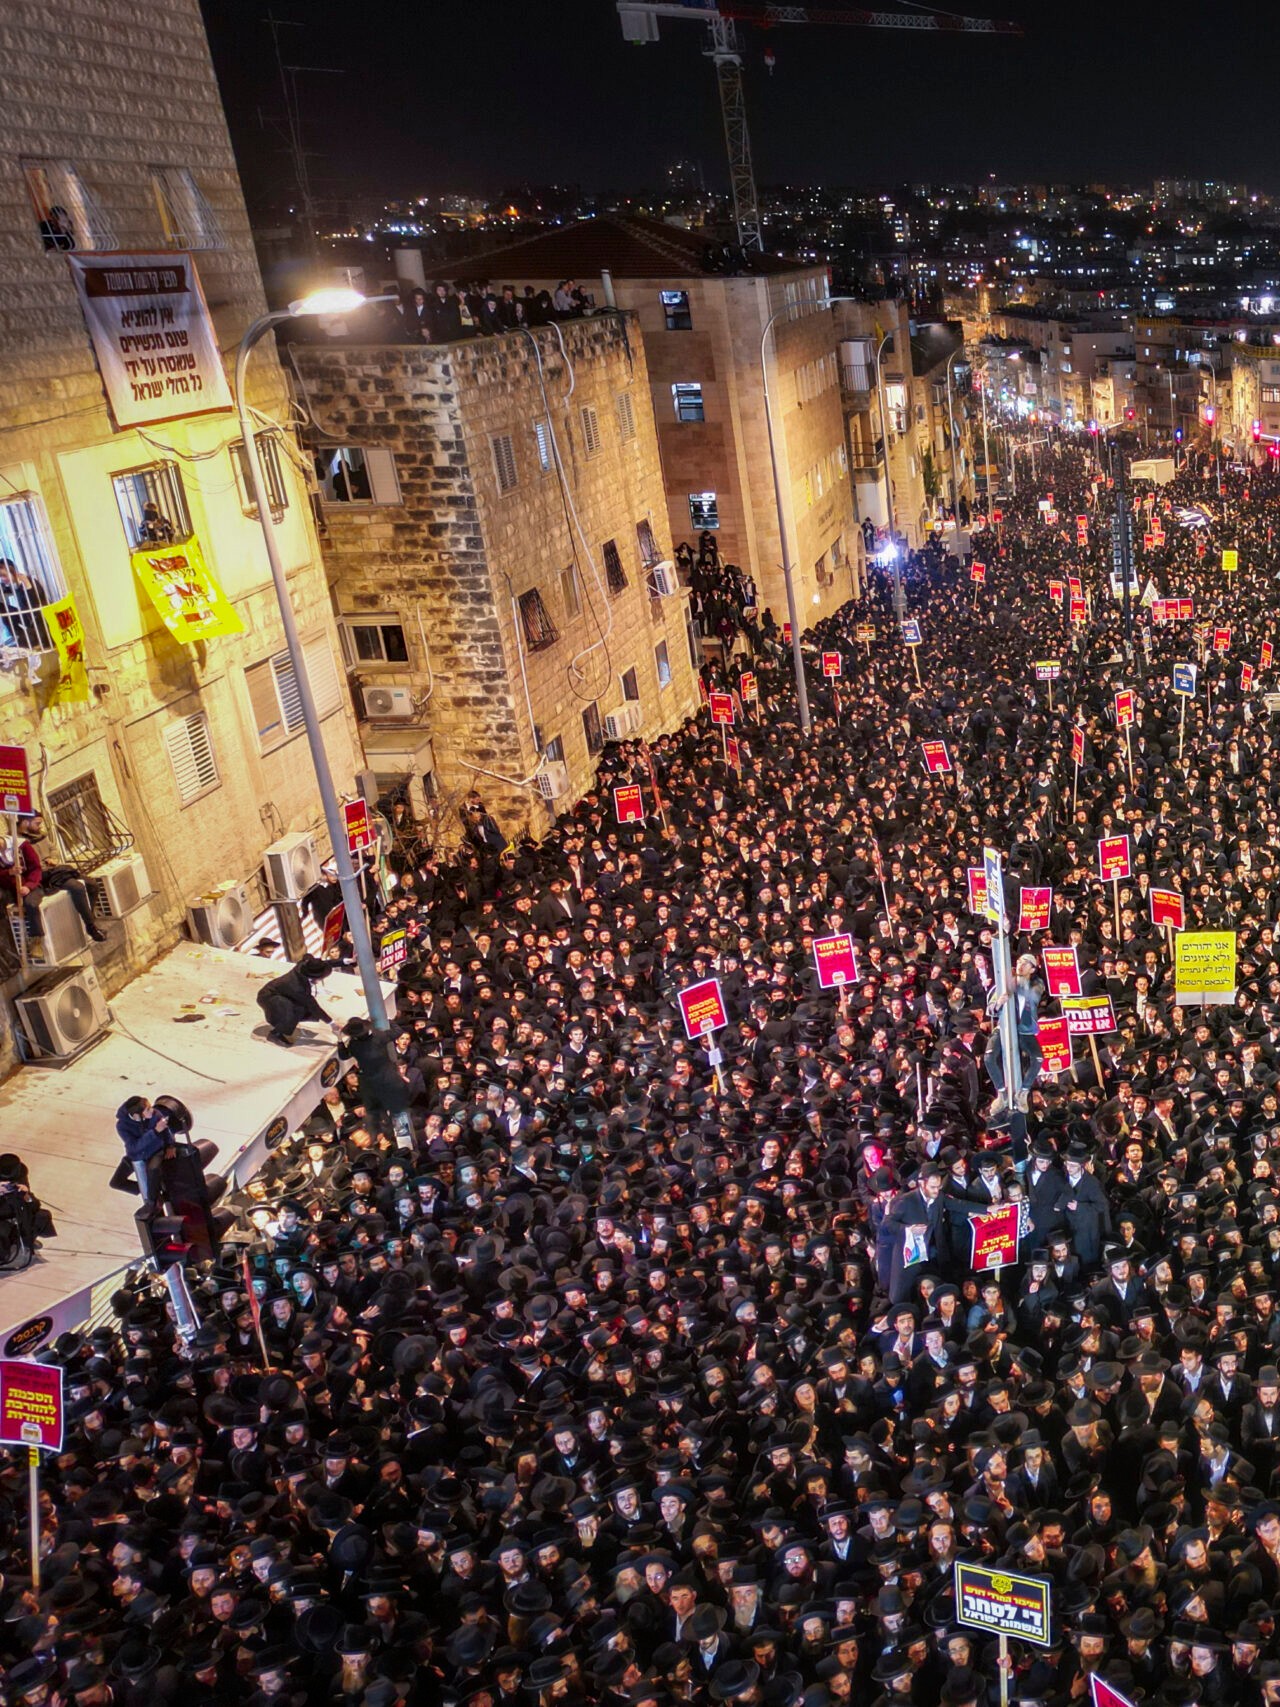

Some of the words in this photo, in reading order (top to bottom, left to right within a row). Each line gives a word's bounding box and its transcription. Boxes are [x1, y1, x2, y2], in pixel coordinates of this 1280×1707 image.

[121, 305, 157, 328] להוציא
[159, 306, 175, 329] אין
[119, 333, 164, 353] מכשירים
[164, 330, 189, 348] שום
[125, 360, 140, 378] ידי
[140, 357, 156, 377] על
[157, 353, 197, 374] שנאסרו
[131, 380, 164, 401] ישראל
[166, 377, 190, 395] גדולי
[189, 373, 202, 391] כל
[1182, 943, 1212, 951] יהודים
[1066, 1010, 1092, 1020] חרדי
[1093, 1008, 1109, 1019] או
[1070, 1020, 1094, 1030] צבא
[1095, 1018, 1111, 1030] או
[8, 1387, 53, 1404] הסכמה
[5, 1399, 57, 1415] להחרבת
[6, 1409, 56, 1426] היהדות
[986, 1590, 1012, 1603] החרדי
[1012, 1596, 1041, 1610] הציבור
[963, 1594, 1019, 1620] לסחר
[963, 1607, 997, 1625] ישראל
[1022, 1606, 1043, 1626] די
[999, 1618, 1044, 1636] בנשמות
